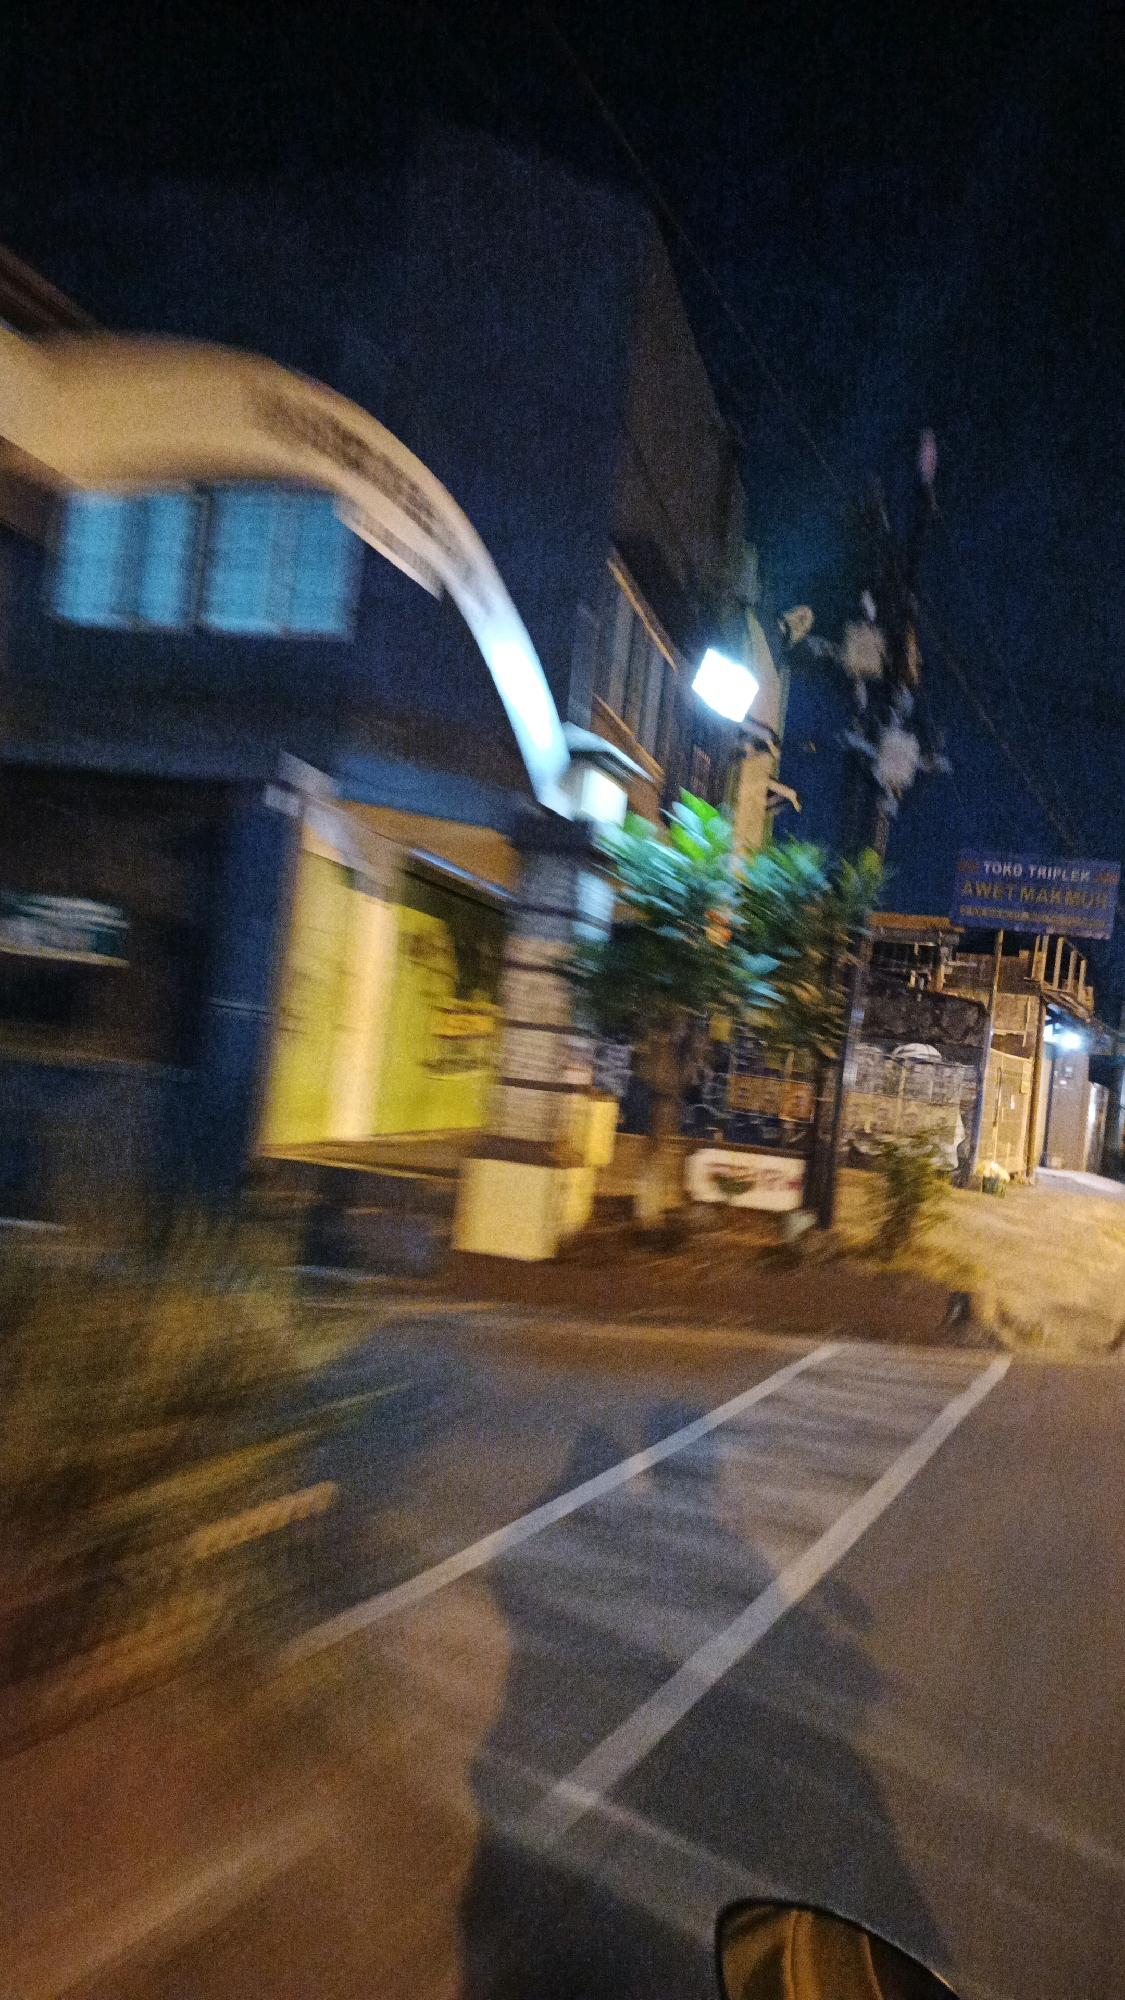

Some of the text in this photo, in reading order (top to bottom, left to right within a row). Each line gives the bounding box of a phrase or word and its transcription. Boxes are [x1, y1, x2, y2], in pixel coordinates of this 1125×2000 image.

[983, 860, 1023, 877] TOKO
[1028, 864, 1091, 882] TRIPLEK
[961, 880, 1017, 899] AWET
